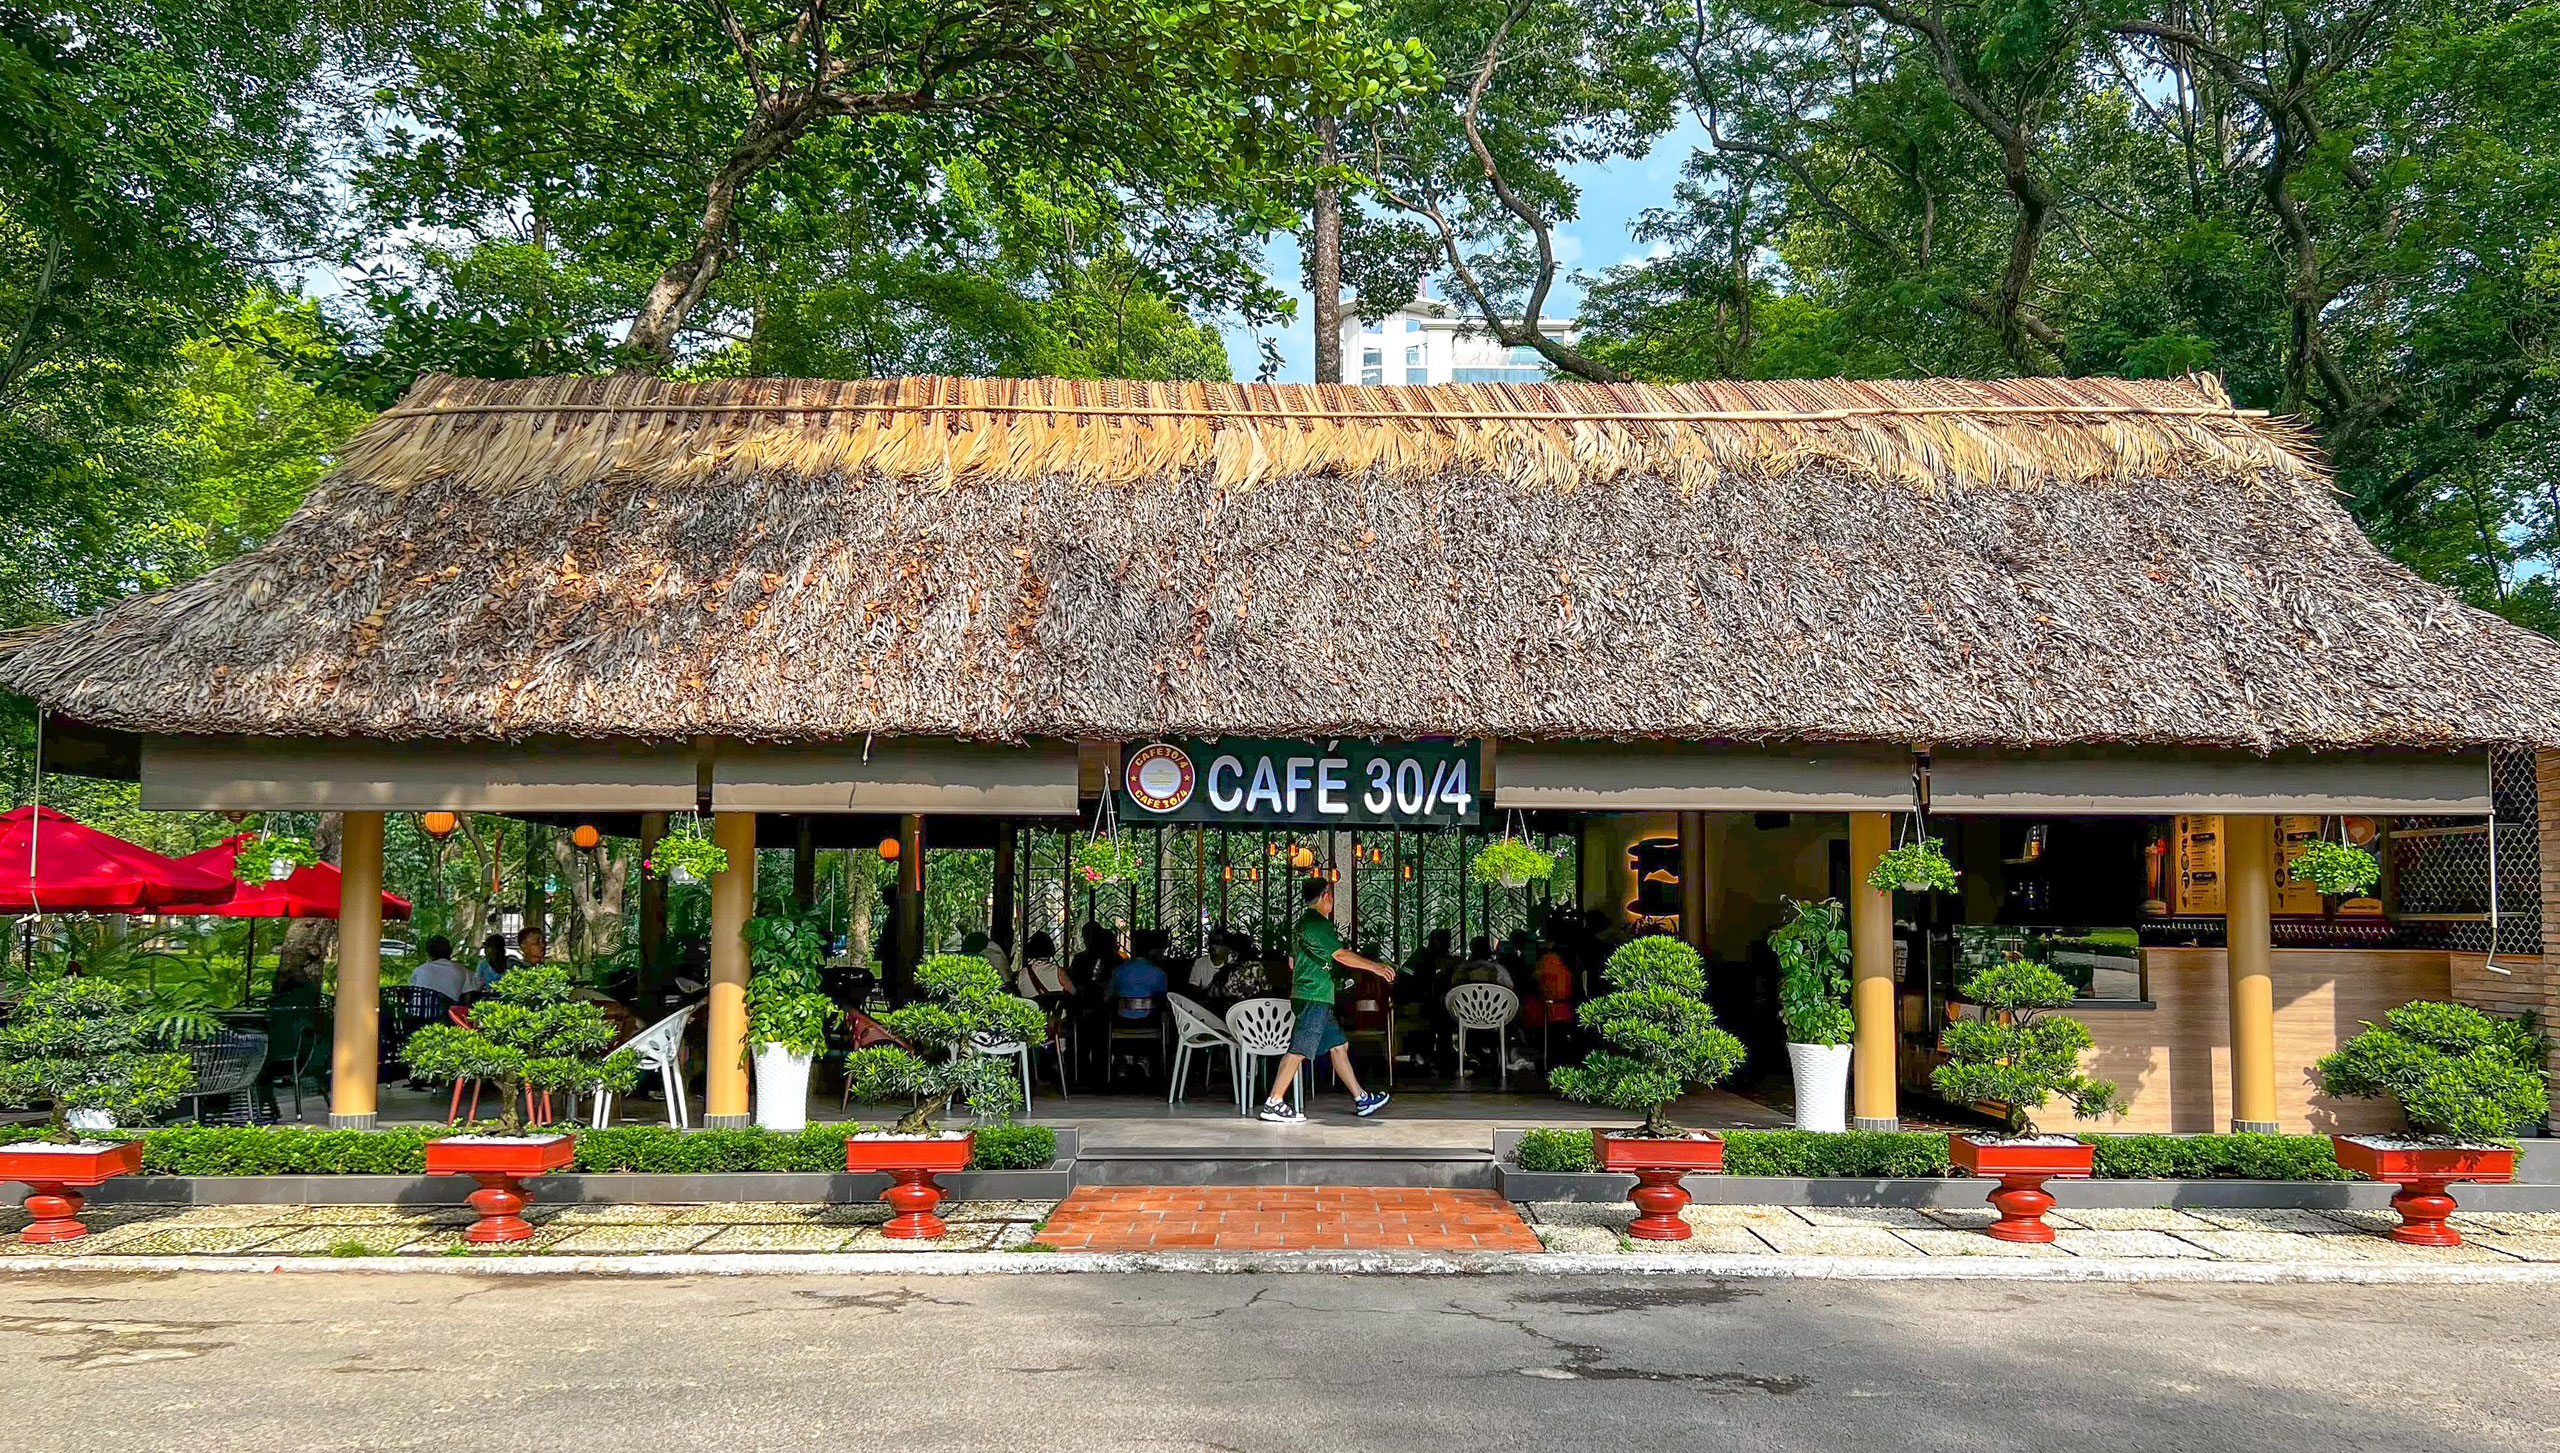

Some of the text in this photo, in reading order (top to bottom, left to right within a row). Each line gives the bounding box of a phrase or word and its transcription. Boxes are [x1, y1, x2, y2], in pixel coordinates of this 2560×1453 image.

[1165, 748, 1189, 769] 30/4
[1207, 740, 1472, 816] CAFÉ 30/4
[1162, 790, 1188, 809] 30/4
